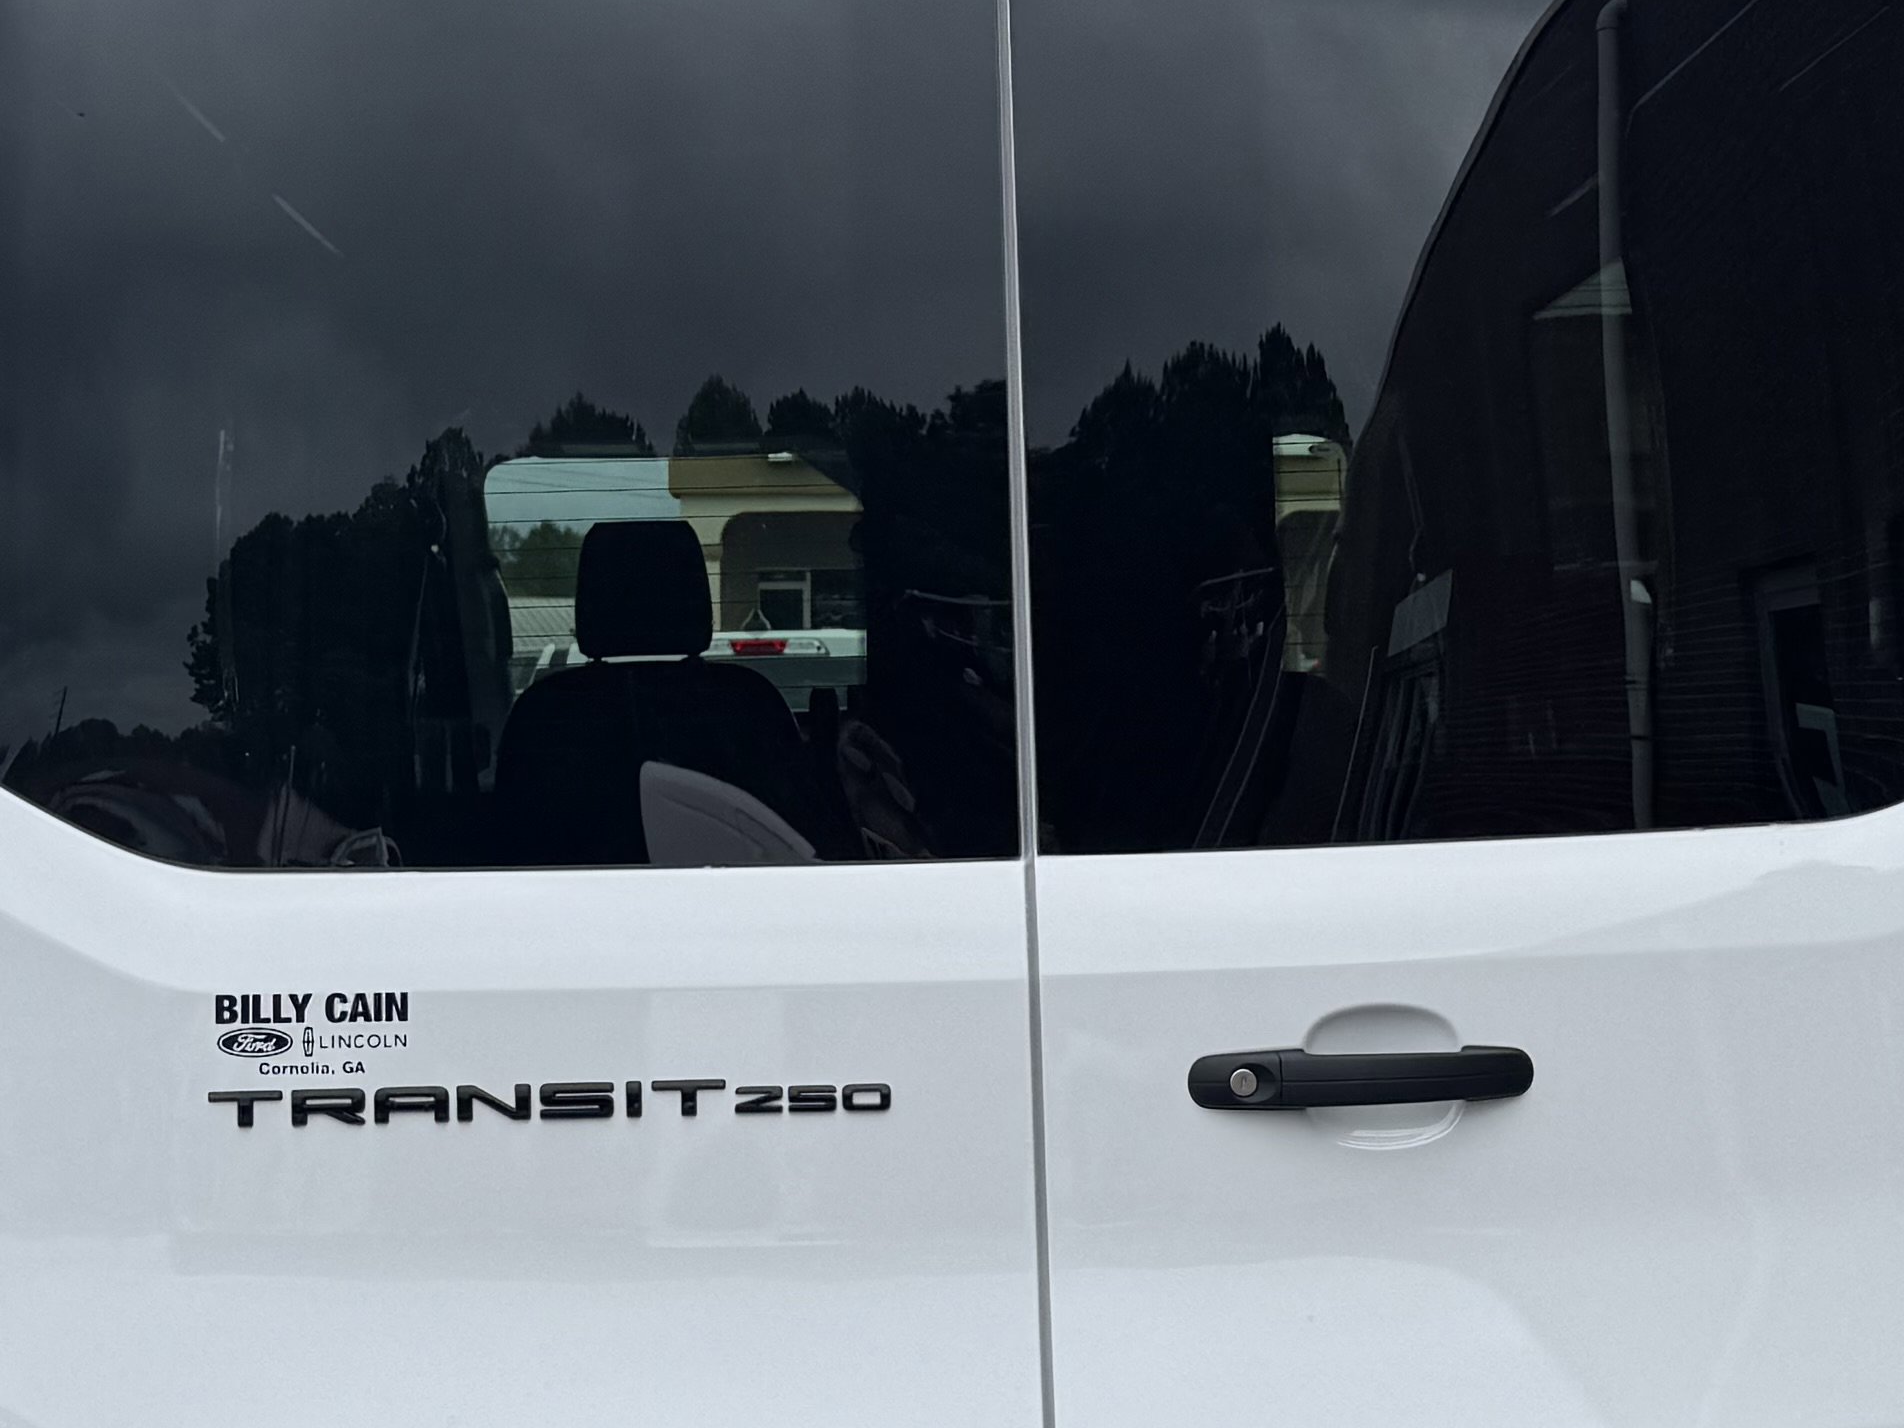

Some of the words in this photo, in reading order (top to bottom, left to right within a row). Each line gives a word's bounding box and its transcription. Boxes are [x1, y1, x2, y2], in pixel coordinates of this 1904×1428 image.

[215, 993, 313, 1024] BILLY
[324, 992, 409, 1023] CAIN
[319, 1034, 408, 1049] LINCOLN
[342, 1060, 366, 1074] GA
[208, 1078, 727, 1128] TRANSIT
[734, 1082, 893, 1115] 250
